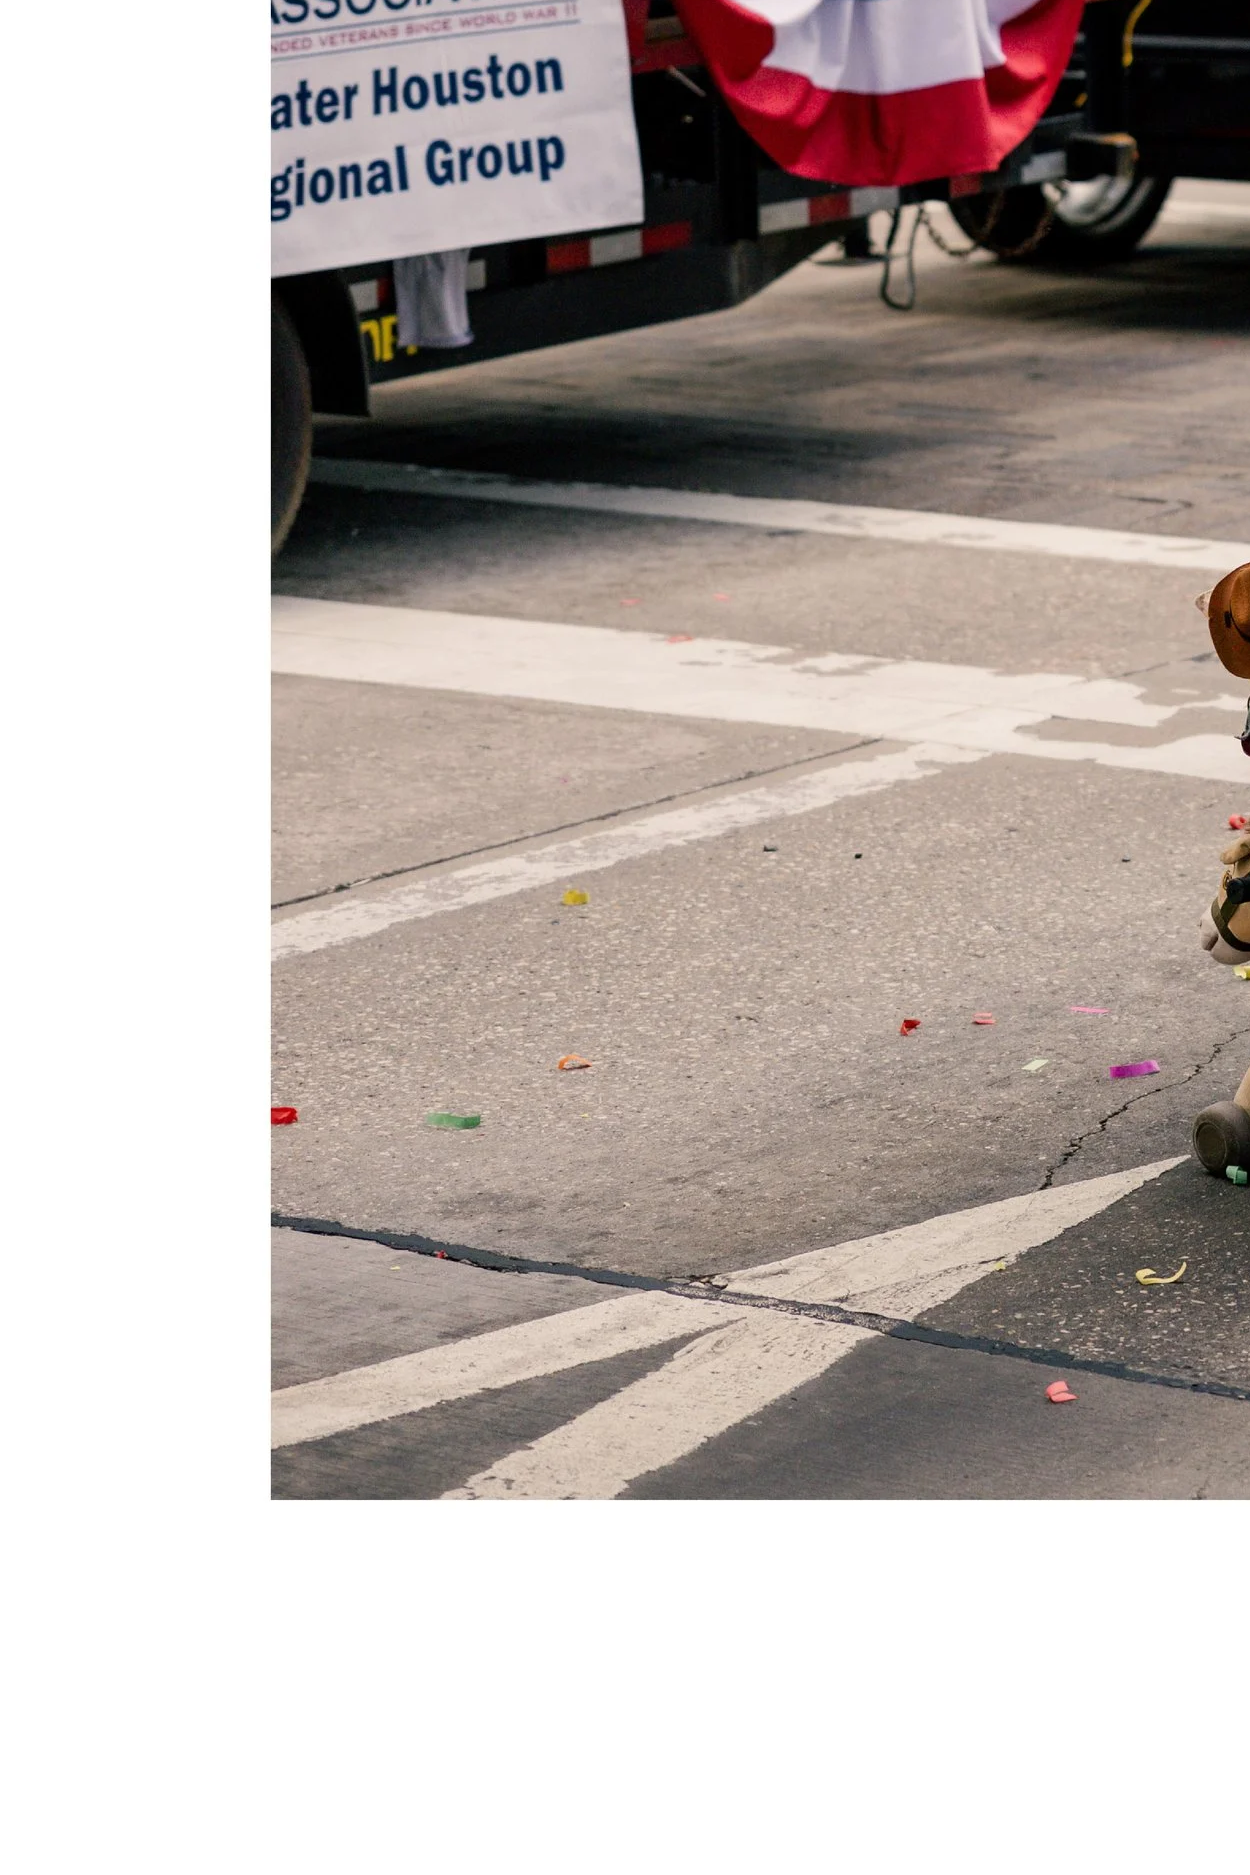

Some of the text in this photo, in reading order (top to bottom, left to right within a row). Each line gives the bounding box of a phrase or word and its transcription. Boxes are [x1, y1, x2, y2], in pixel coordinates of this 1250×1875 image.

[318, 26, 398, 47] VETERANS
[404, 20, 450, 37] SINCE
[458, 13, 517, 30] WORLD
[523, 8, 558, 22] WAR
[271, 56, 565, 130] ater Houston
[271, 134, 566, 222] gional Group
